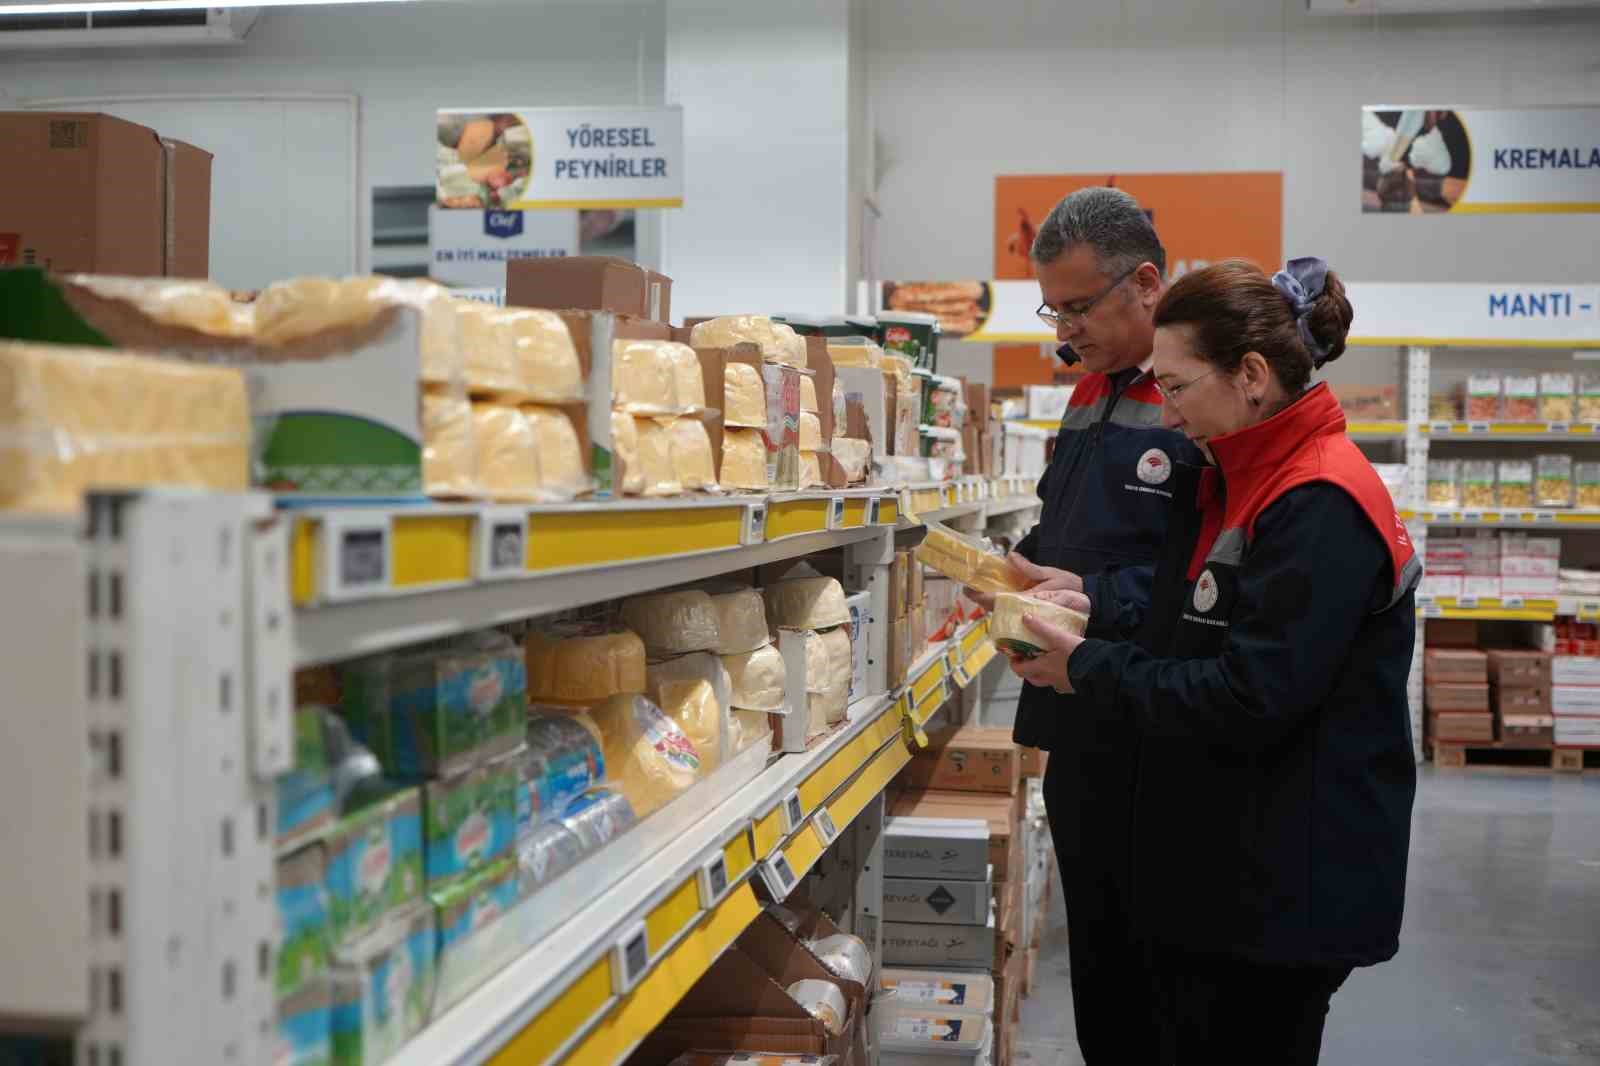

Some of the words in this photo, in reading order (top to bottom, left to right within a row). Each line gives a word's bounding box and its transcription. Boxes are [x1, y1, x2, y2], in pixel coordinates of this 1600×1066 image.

[567, 124, 655, 148] YÖRESEL
[555, 154, 667, 179] PEYNİRLER
[1489, 293, 1571, 317] MANTI
